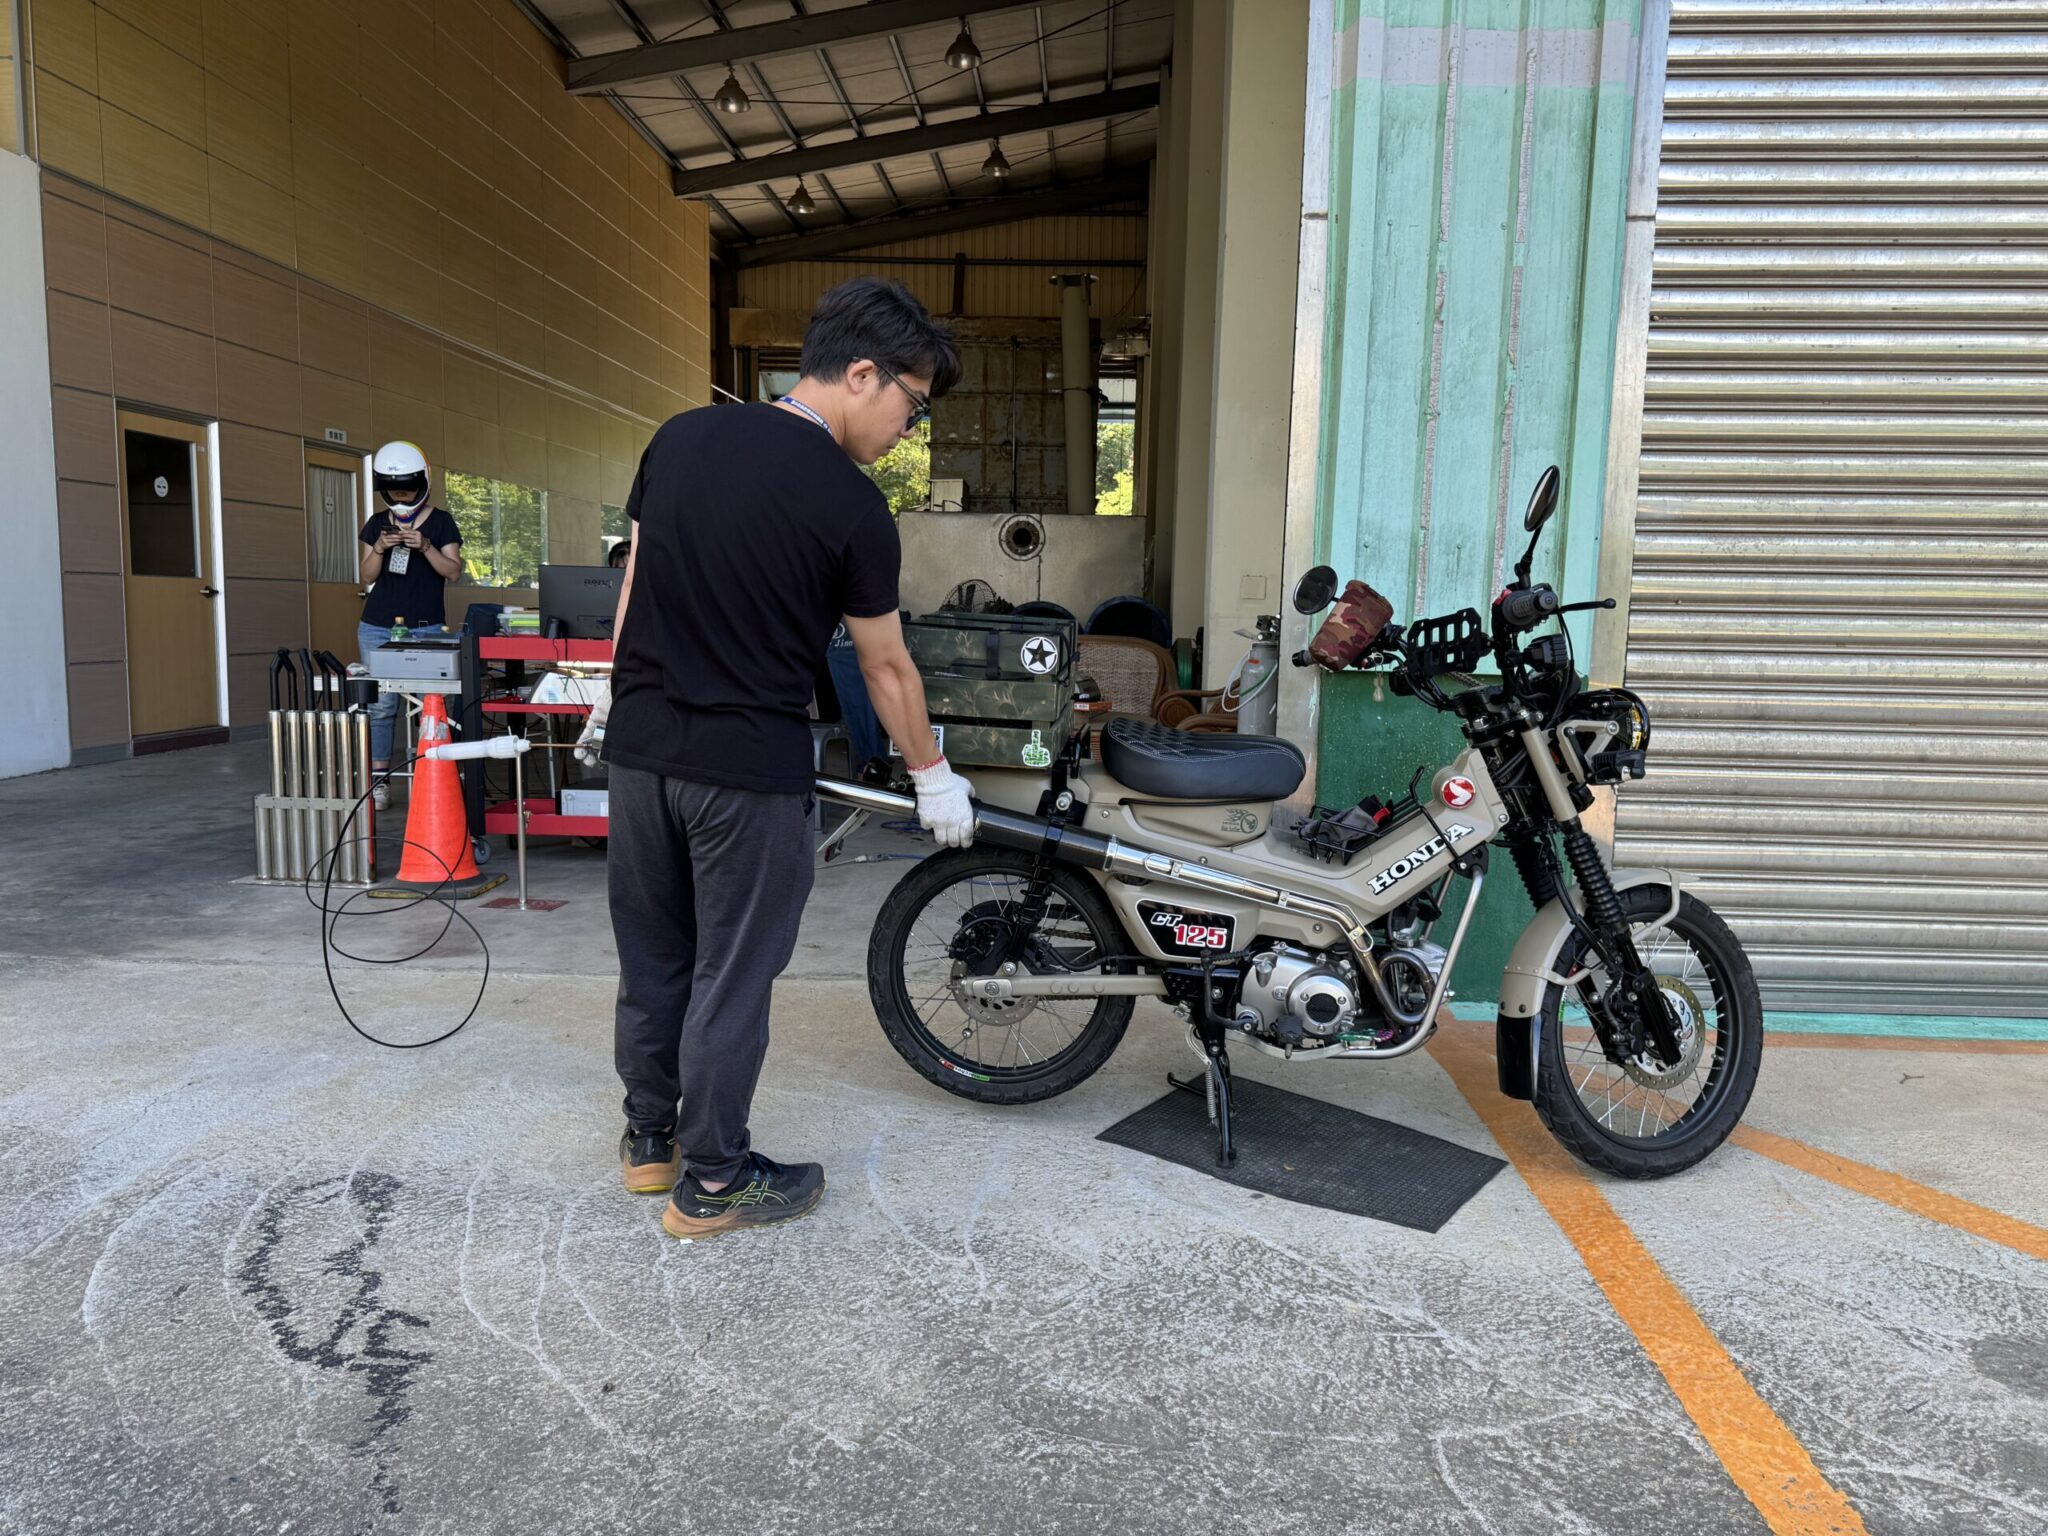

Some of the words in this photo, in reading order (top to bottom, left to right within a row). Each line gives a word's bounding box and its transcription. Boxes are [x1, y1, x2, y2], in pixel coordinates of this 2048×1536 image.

[1367, 823, 1475, 895] HONDA
[1150, 912, 1183, 927] CT
[1174, 924, 1227, 949] 125
